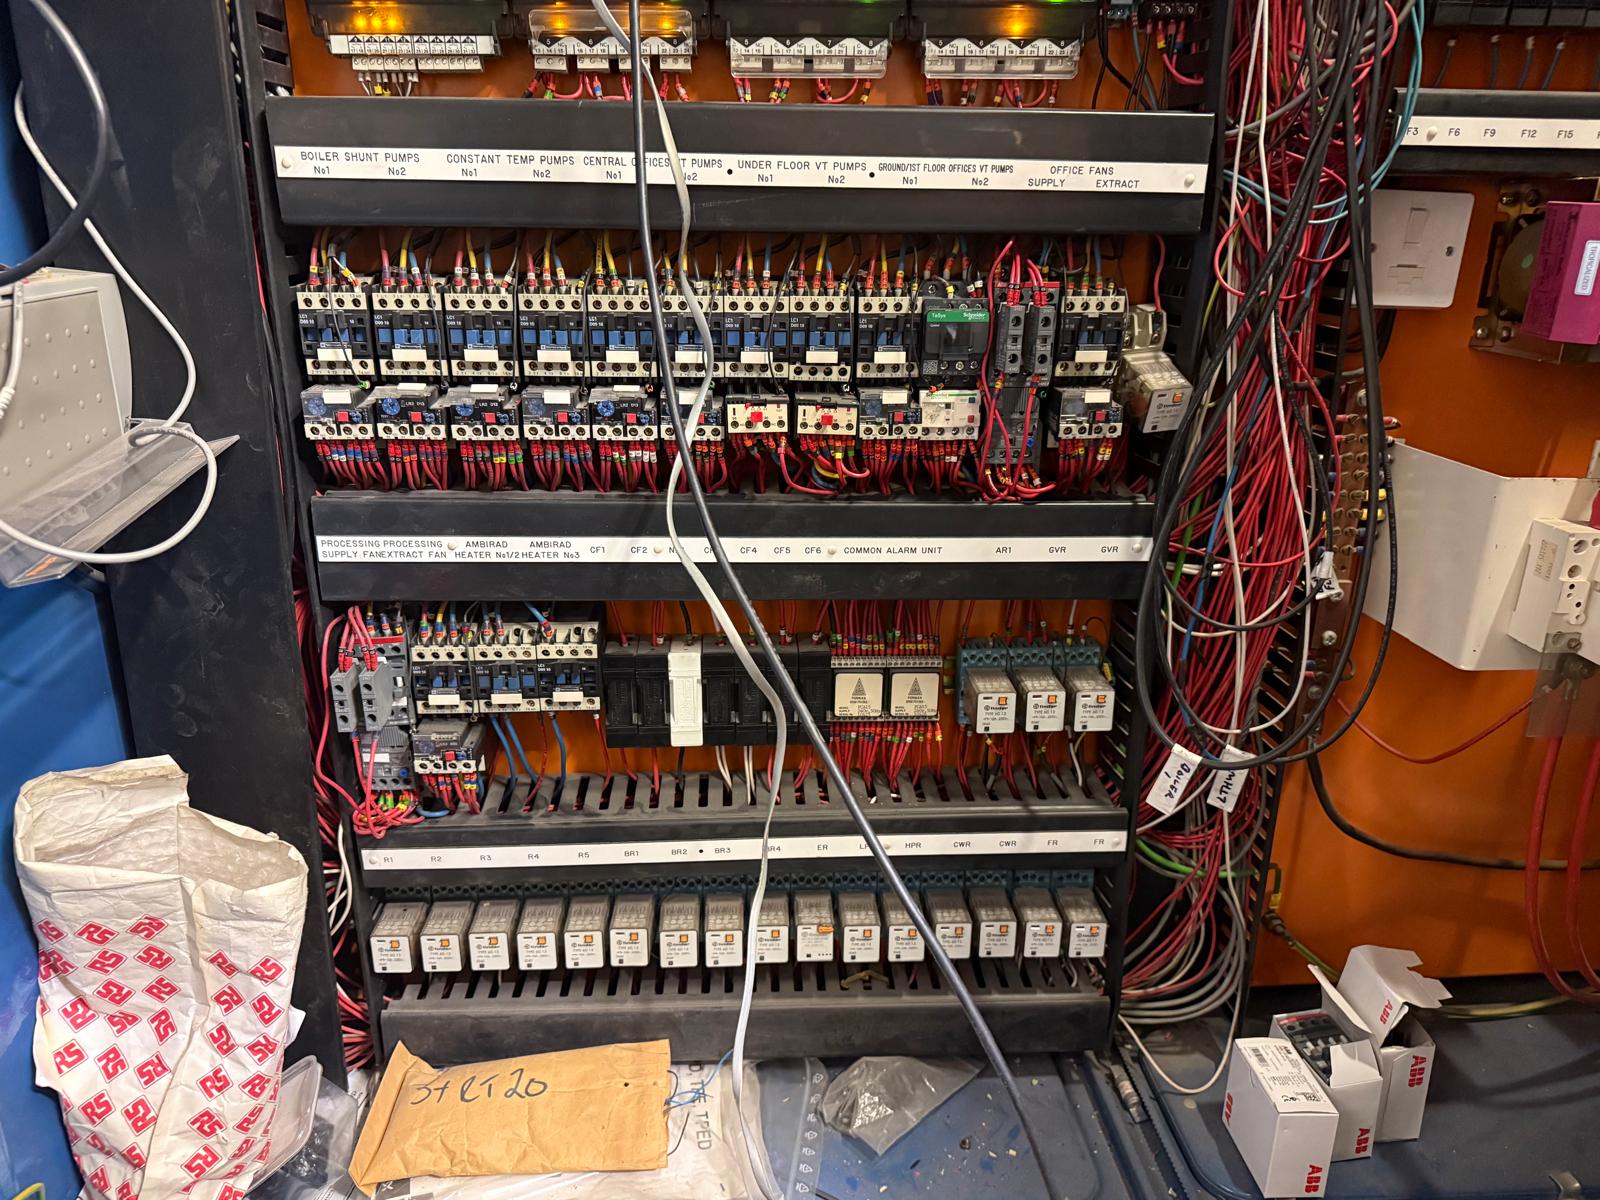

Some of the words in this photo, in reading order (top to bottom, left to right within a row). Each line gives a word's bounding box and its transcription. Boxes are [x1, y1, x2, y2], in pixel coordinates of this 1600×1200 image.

[1407, 127, 1419, 136] F3
[1448, 128, 1461, 137] F6
[1483, 129, 1496, 138] F9
[1521, 129, 1538, 139] F12
[1557, 130, 1574, 139] F15
[300, 151, 340, 161] BOILER
[344, 152, 379, 162] SHUNT
[384, 153, 420, 163] PUMPS
[446, 154, 500, 164] CONSTANT
[507, 155, 535, 165] TEMP
[540, 156, 575, 165] PUMPS
[583, 156, 627, 166] CENTRAL
[691, 159, 723, 168] PUMPS
[737, 160, 772, 169] UNDER
[777, 161, 810, 170] FLOOR
[815, 162, 829, 171] VT
[833, 162, 867, 171] PUMPS
[923, 164, 946, 172] FLOOR
[948, 165, 976, 174] OFFICES
[979, 165, 989, 174] VT
[991, 165, 1014, 174] PUMPS
[313, 166, 330, 175] No1
[388, 167, 407, 176] No2
[461, 168, 478, 177] No1
[533, 169, 551, 178] No2
[606, 171, 622, 180] No1
[757, 174, 774, 183] No1
[828, 175, 846, 184] No2
[902, 176, 919, 185] No1
[971, 177, 989, 186] No2
[1028, 178, 1066, 188] SUPPLY
[1095, 179, 1140, 189] EXTRACT
[1050, 166, 1084, 175] OFFICE
[1089, 167, 1114, 176] FANS
[321, 540, 381, 549] PROCESSING
[383, 540, 443, 549] PROCESSING
[321, 550, 358, 559] SUPPLY
[428, 551, 447, 559] FAN
[455, 551, 492, 559] HEATER
[495, 551, 520, 559] No1/2
[465, 540, 508, 549] AMBIRAD
[521, 551, 559, 560] HEATER
[563, 551, 581, 560] No3
[529, 541, 572, 549] AMBIRAD
[590, 546, 605, 554] CF1
[630, 546, 648, 554] CF2
[740, 546, 757, 554] CF4
[773, 546, 791, 555] CF5
[804, 546, 822, 555] CF6
[843, 546, 882, 554] COMMON
[921, 546, 943, 554] UNIT
[995, 546, 1012, 554] AR1
[1048, 546, 1066, 554] GVR
[1100, 545, 1119, 553] GVR
[480, 854, 492, 862] R3
[527, 853, 540, 861] R4
[577, 851, 590, 859] R5
[905, 841, 922, 849] HPR
[953, 841, 971, 849] CWR
[999, 840, 1017, 848] CWR
[75, 922, 117, 946] RS
[86, 949, 126, 975] RS
[135, 945, 174, 970] RS
[208, 951, 240, 978] RS
[249, 957, 285, 985] RS
[95, 979, 134, 1006] RS
[144, 976, 179, 1003] RS
[213, 984, 245, 1015] RS
[61, 996, 98, 1031] RS
[251, 994, 284, 1026] RS
[1379, 999, 1393, 1025] ABB
[149, 1008, 177, 1044] RS
[208, 1023, 238, 1057] RS
[246, 1034, 279, 1063] RS
[53, 1041, 86, 1074] RS
[97, 1045, 127, 1081] RS
[135, 1053, 170, 1087] RS
[198, 1066, 232, 1100] RS
[503, 1067, 548, 1099] 20
[1408, 1055, 1427, 1088] ABB
[240, 1073, 272, 1099] RS
[80, 1091, 114, 1126] RS
[122, 1097, 157, 1135] RS
[235, 1104, 265, 1133] RS
[189, 1109, 225, 1138] RS
[1355, 1127, 1371, 1154] ABB
[183, 1145, 221, 1180] RS
[1304, 1164, 1323, 1193] ABB
